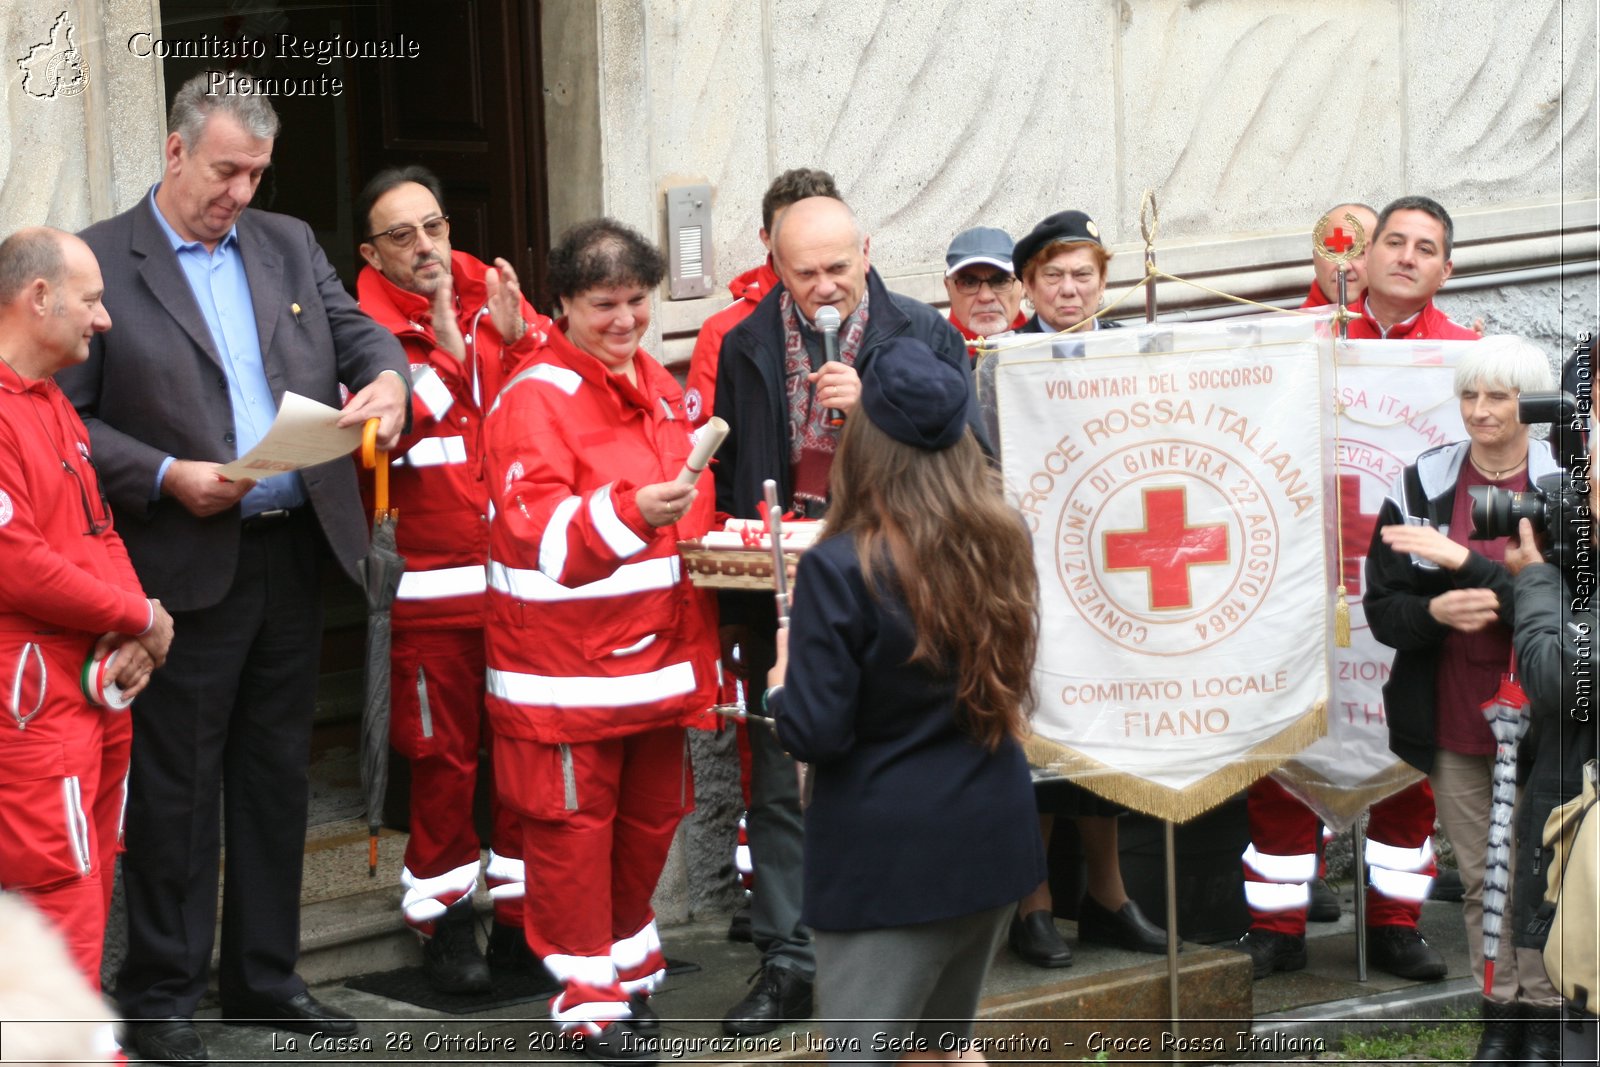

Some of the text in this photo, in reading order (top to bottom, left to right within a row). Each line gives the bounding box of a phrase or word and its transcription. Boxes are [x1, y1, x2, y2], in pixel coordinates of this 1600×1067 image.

[1045, 365, 1273, 400] VOLONTARI DEL SOCCORSO
[1083, 399, 1195, 446] ROSSA
[1204, 403, 1315, 518] ITALIANA
[1063, 445, 1273, 644] CONVENZIONE DI GINEVRA 22 AGOSTO 1864
[1061, 670, 1288, 705] COMITATO LOCALE
[1124, 706, 1230, 738] FIANO
